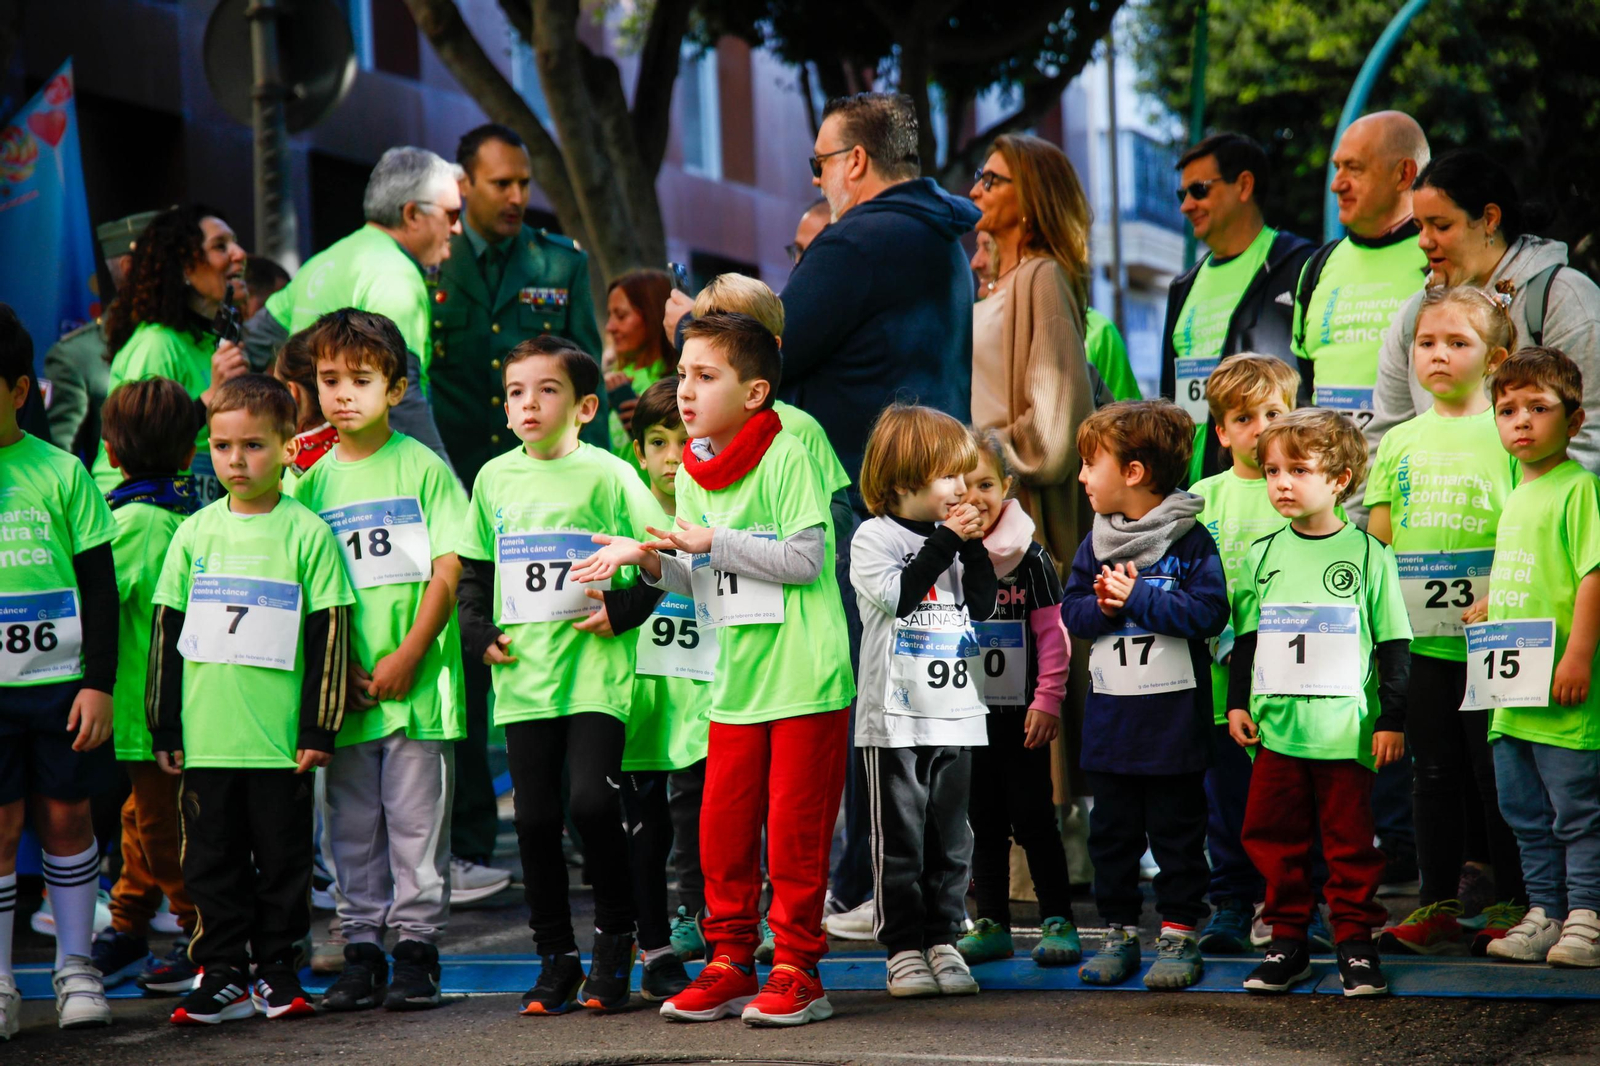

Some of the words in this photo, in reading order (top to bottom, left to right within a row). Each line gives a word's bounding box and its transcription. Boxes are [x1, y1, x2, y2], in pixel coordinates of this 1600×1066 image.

[1334, 311, 1382, 325] contra
[1333, 326, 1390, 343] cánce
[1188, 379, 1208, 401] 6
[1411, 471, 1429, 485] En
[1433, 474, 1492, 492] marcha
[1411, 488, 1466, 505] contra
[1471, 491, 1490, 510] el
[0, 506, 51, 523] archa
[348, 514, 372, 523] cáncer
[1410, 506, 1487, 534] cáncer
[34, 525, 50, 541] el
[346, 528, 392, 560] 18
[501, 538, 524, 546] Almería
[530, 545, 556, 553] cáncer
[1224, 539, 1244, 552] En
[1430, 563, 1457, 571] cáncer
[1514, 566, 1531, 584] el
[526, 561, 572, 592] 87
[194, 587, 213, 595] contra
[222, 588, 248, 596] cáncer
[1424, 579, 1475, 609] 23
[661, 601, 688, 610] cáncer
[226, 605, 249, 634] 7
[1282, 617, 1308, 625] cáncer
[652, 617, 700, 649] 95
[901, 632, 929, 641] Almería
[1469, 627, 1486, 636] Almería
[1470, 637, 1483, 645] contra
[1488, 633, 1508, 642] cáncer
[900, 641, 924, 649] contra
[1113, 635, 1156, 666] 17
[1288, 634, 1305, 664] 1
[1483, 650, 1520, 680] 15
[927, 659, 968, 689] 98
